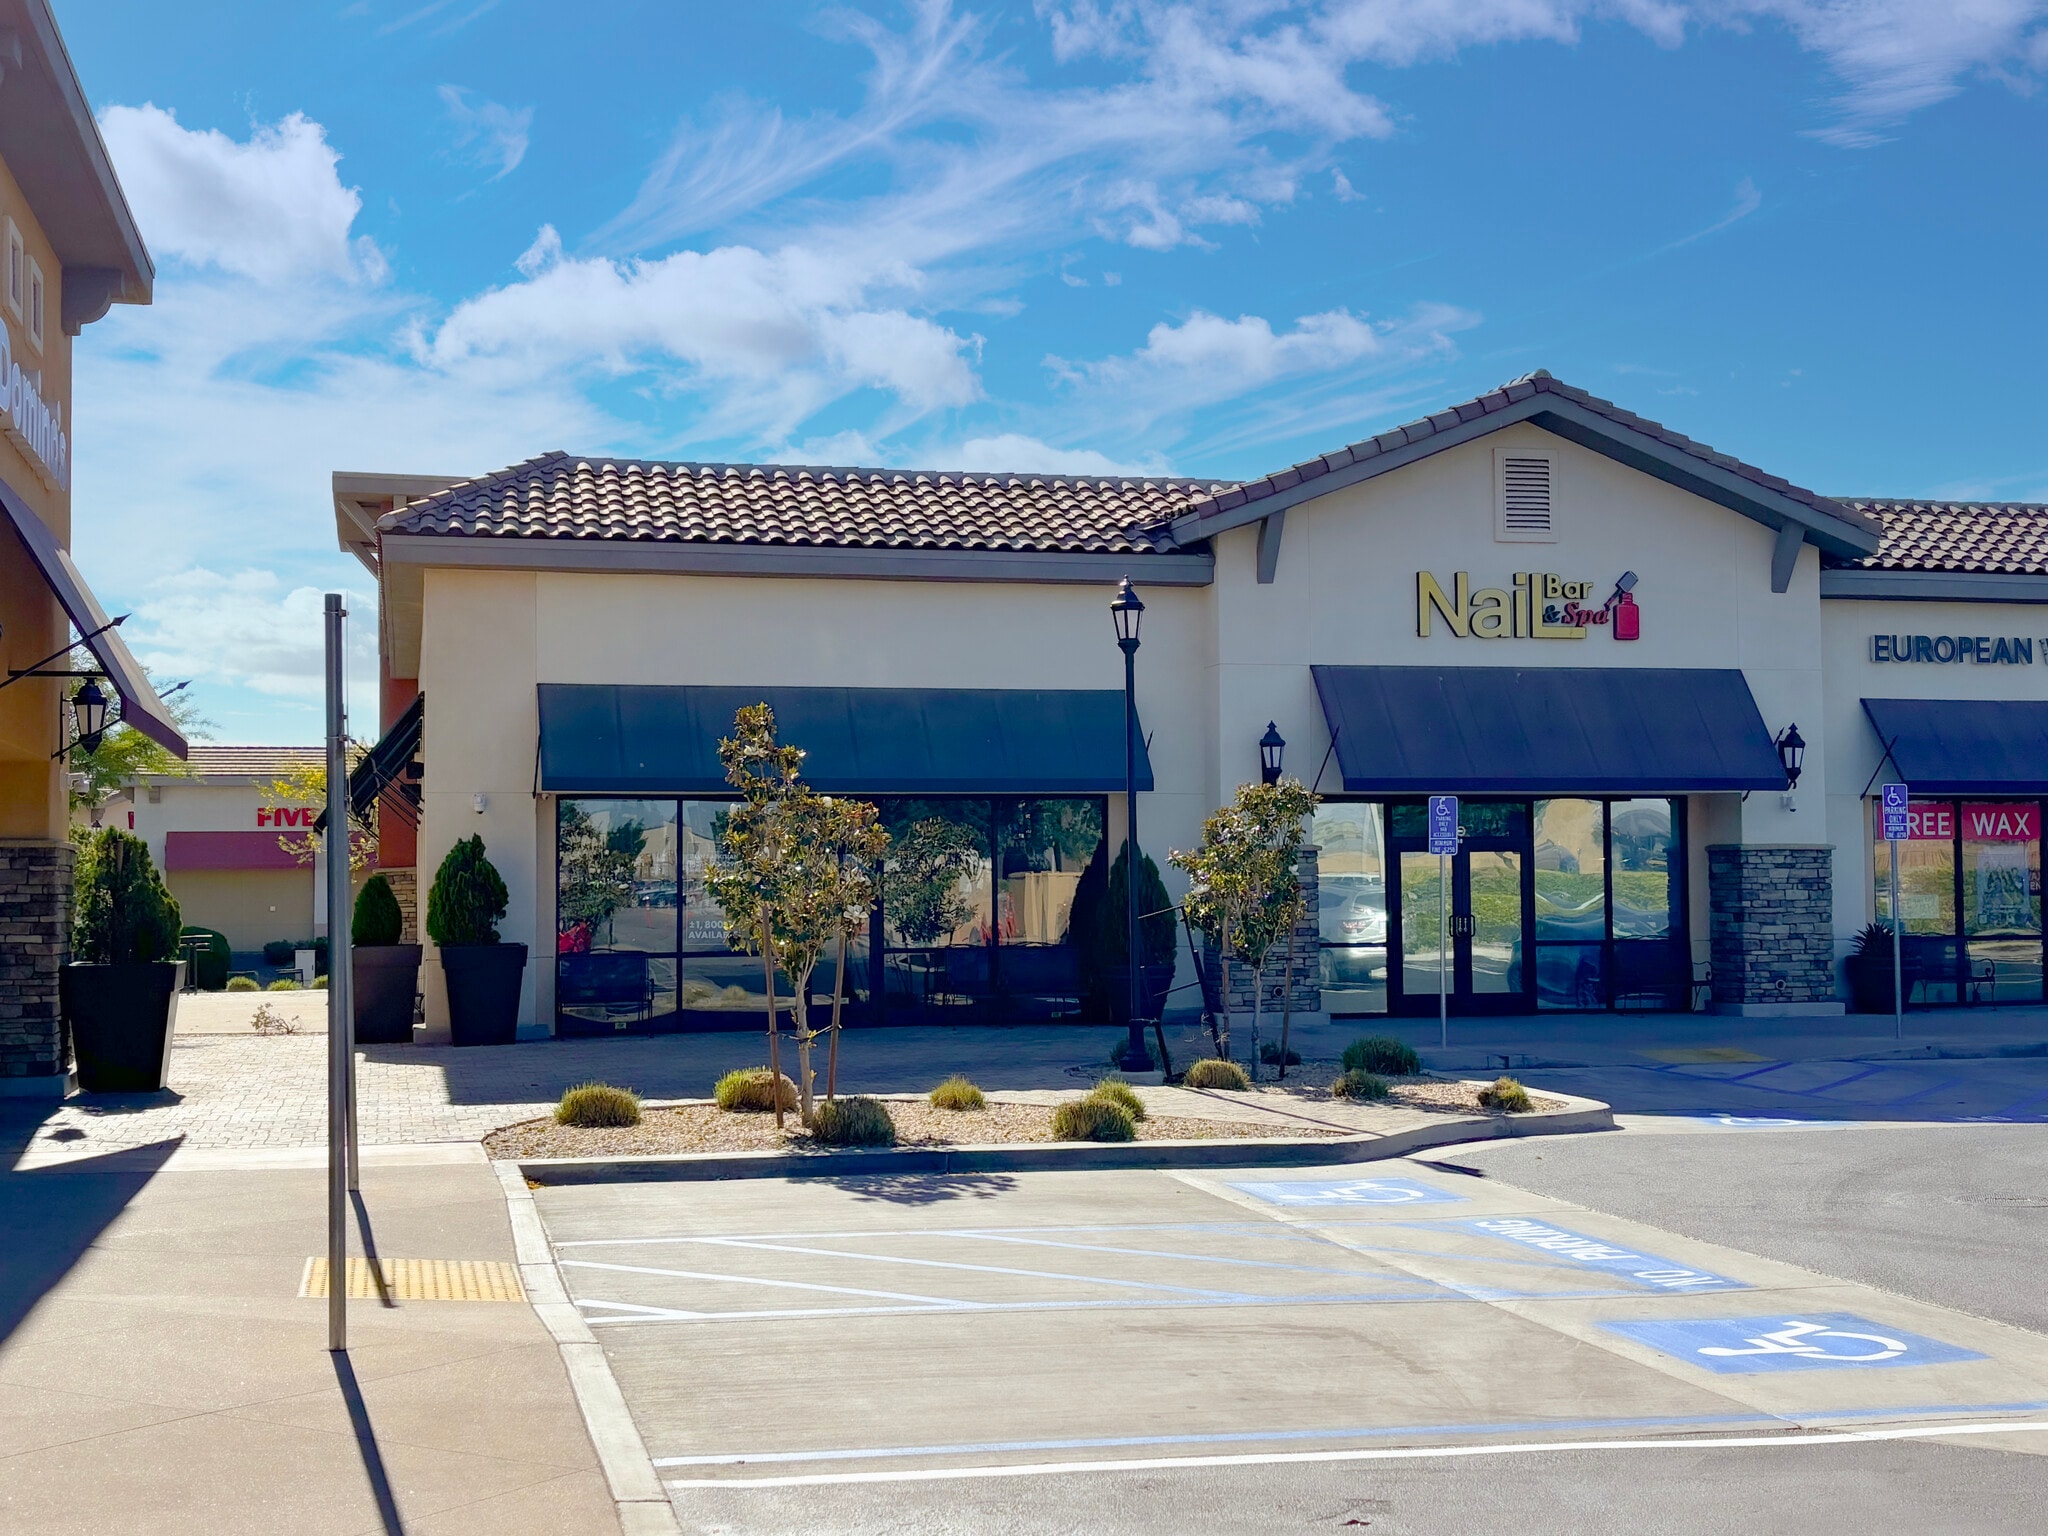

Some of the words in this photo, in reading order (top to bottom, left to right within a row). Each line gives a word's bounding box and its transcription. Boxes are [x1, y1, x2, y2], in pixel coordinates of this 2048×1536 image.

[1544, 573, 1593, 599] Bar
[1543, 605, 1561, 623] &
[1561, 601, 1609, 627] Spa
[1871, 635, 2032, 665] EUROPEAN
[257, 807, 320, 827] FIVE
[1889, 815, 1903, 823] ONLY
[1908, 812, 1951, 836] REE
[1971, 812, 2031, 836] WAX
[1474, 1219, 1641, 1261] PARKING
[1633, 1269, 1725, 1288] NO
